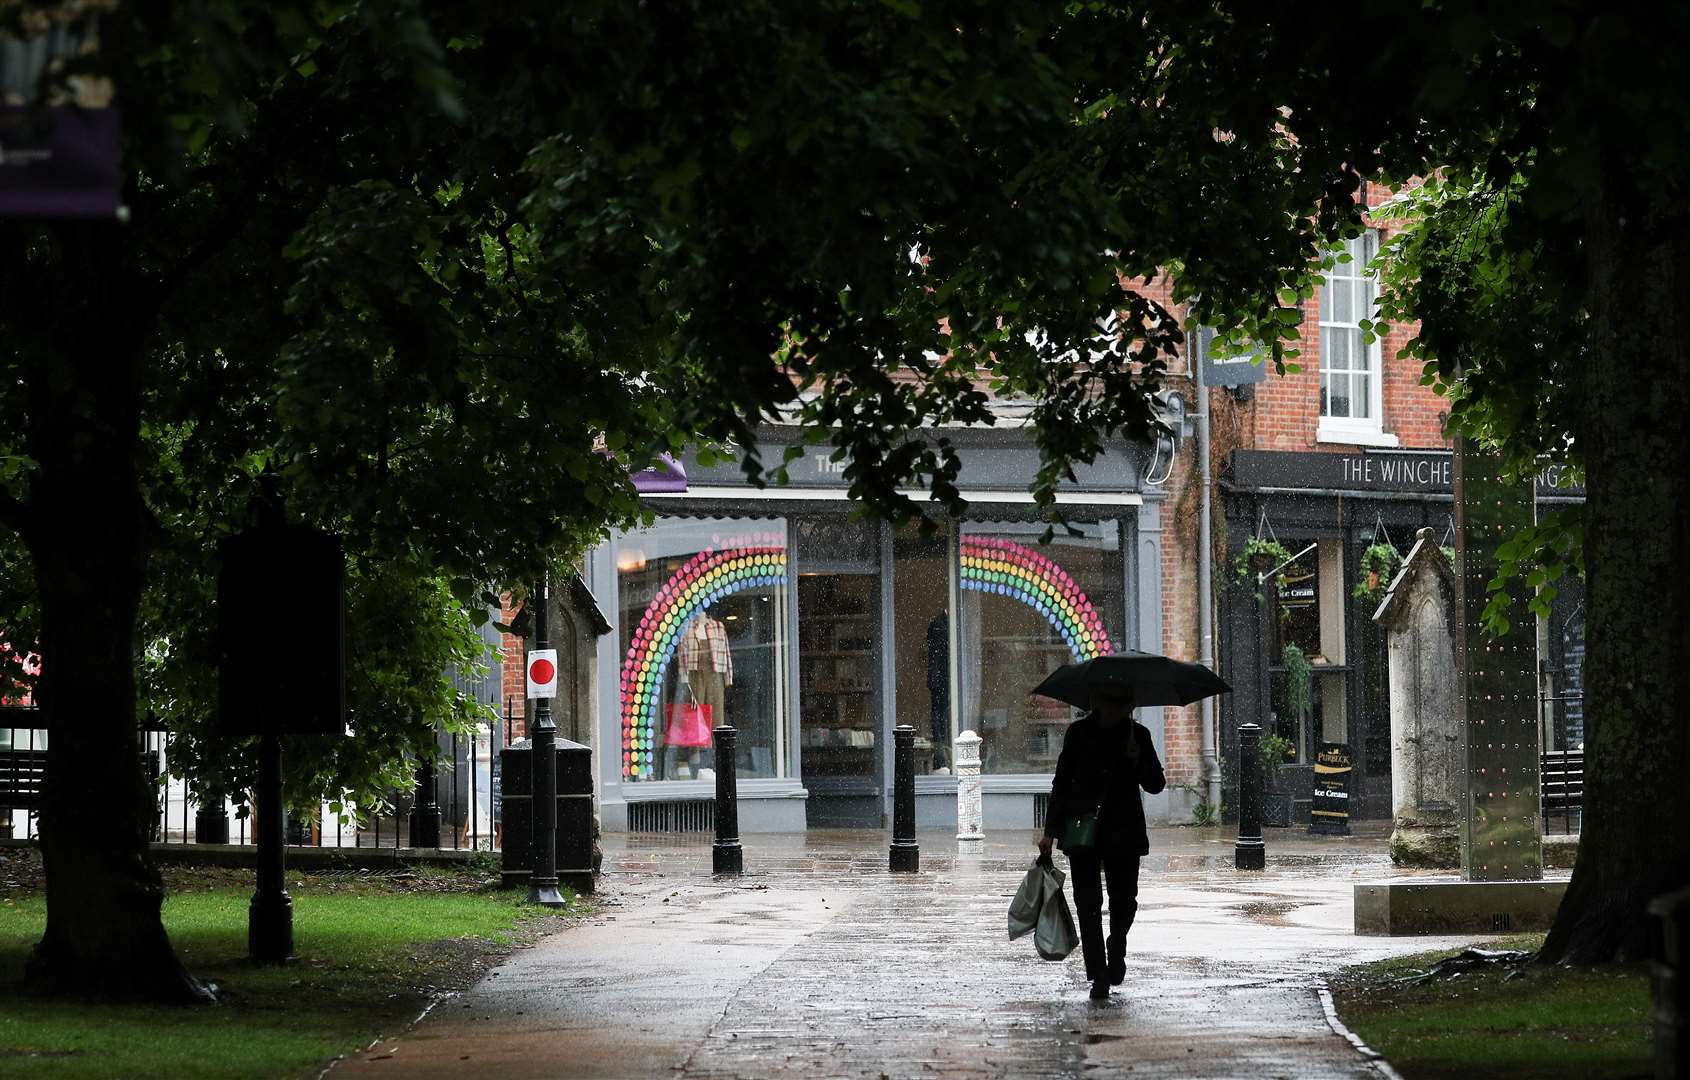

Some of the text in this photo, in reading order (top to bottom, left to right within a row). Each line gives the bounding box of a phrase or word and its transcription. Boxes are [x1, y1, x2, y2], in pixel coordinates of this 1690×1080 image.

[1342, 458, 1373, 482] THE
[1291, 588, 1315, 597] Cream
[1314, 788, 1349, 799] Ice Cream
